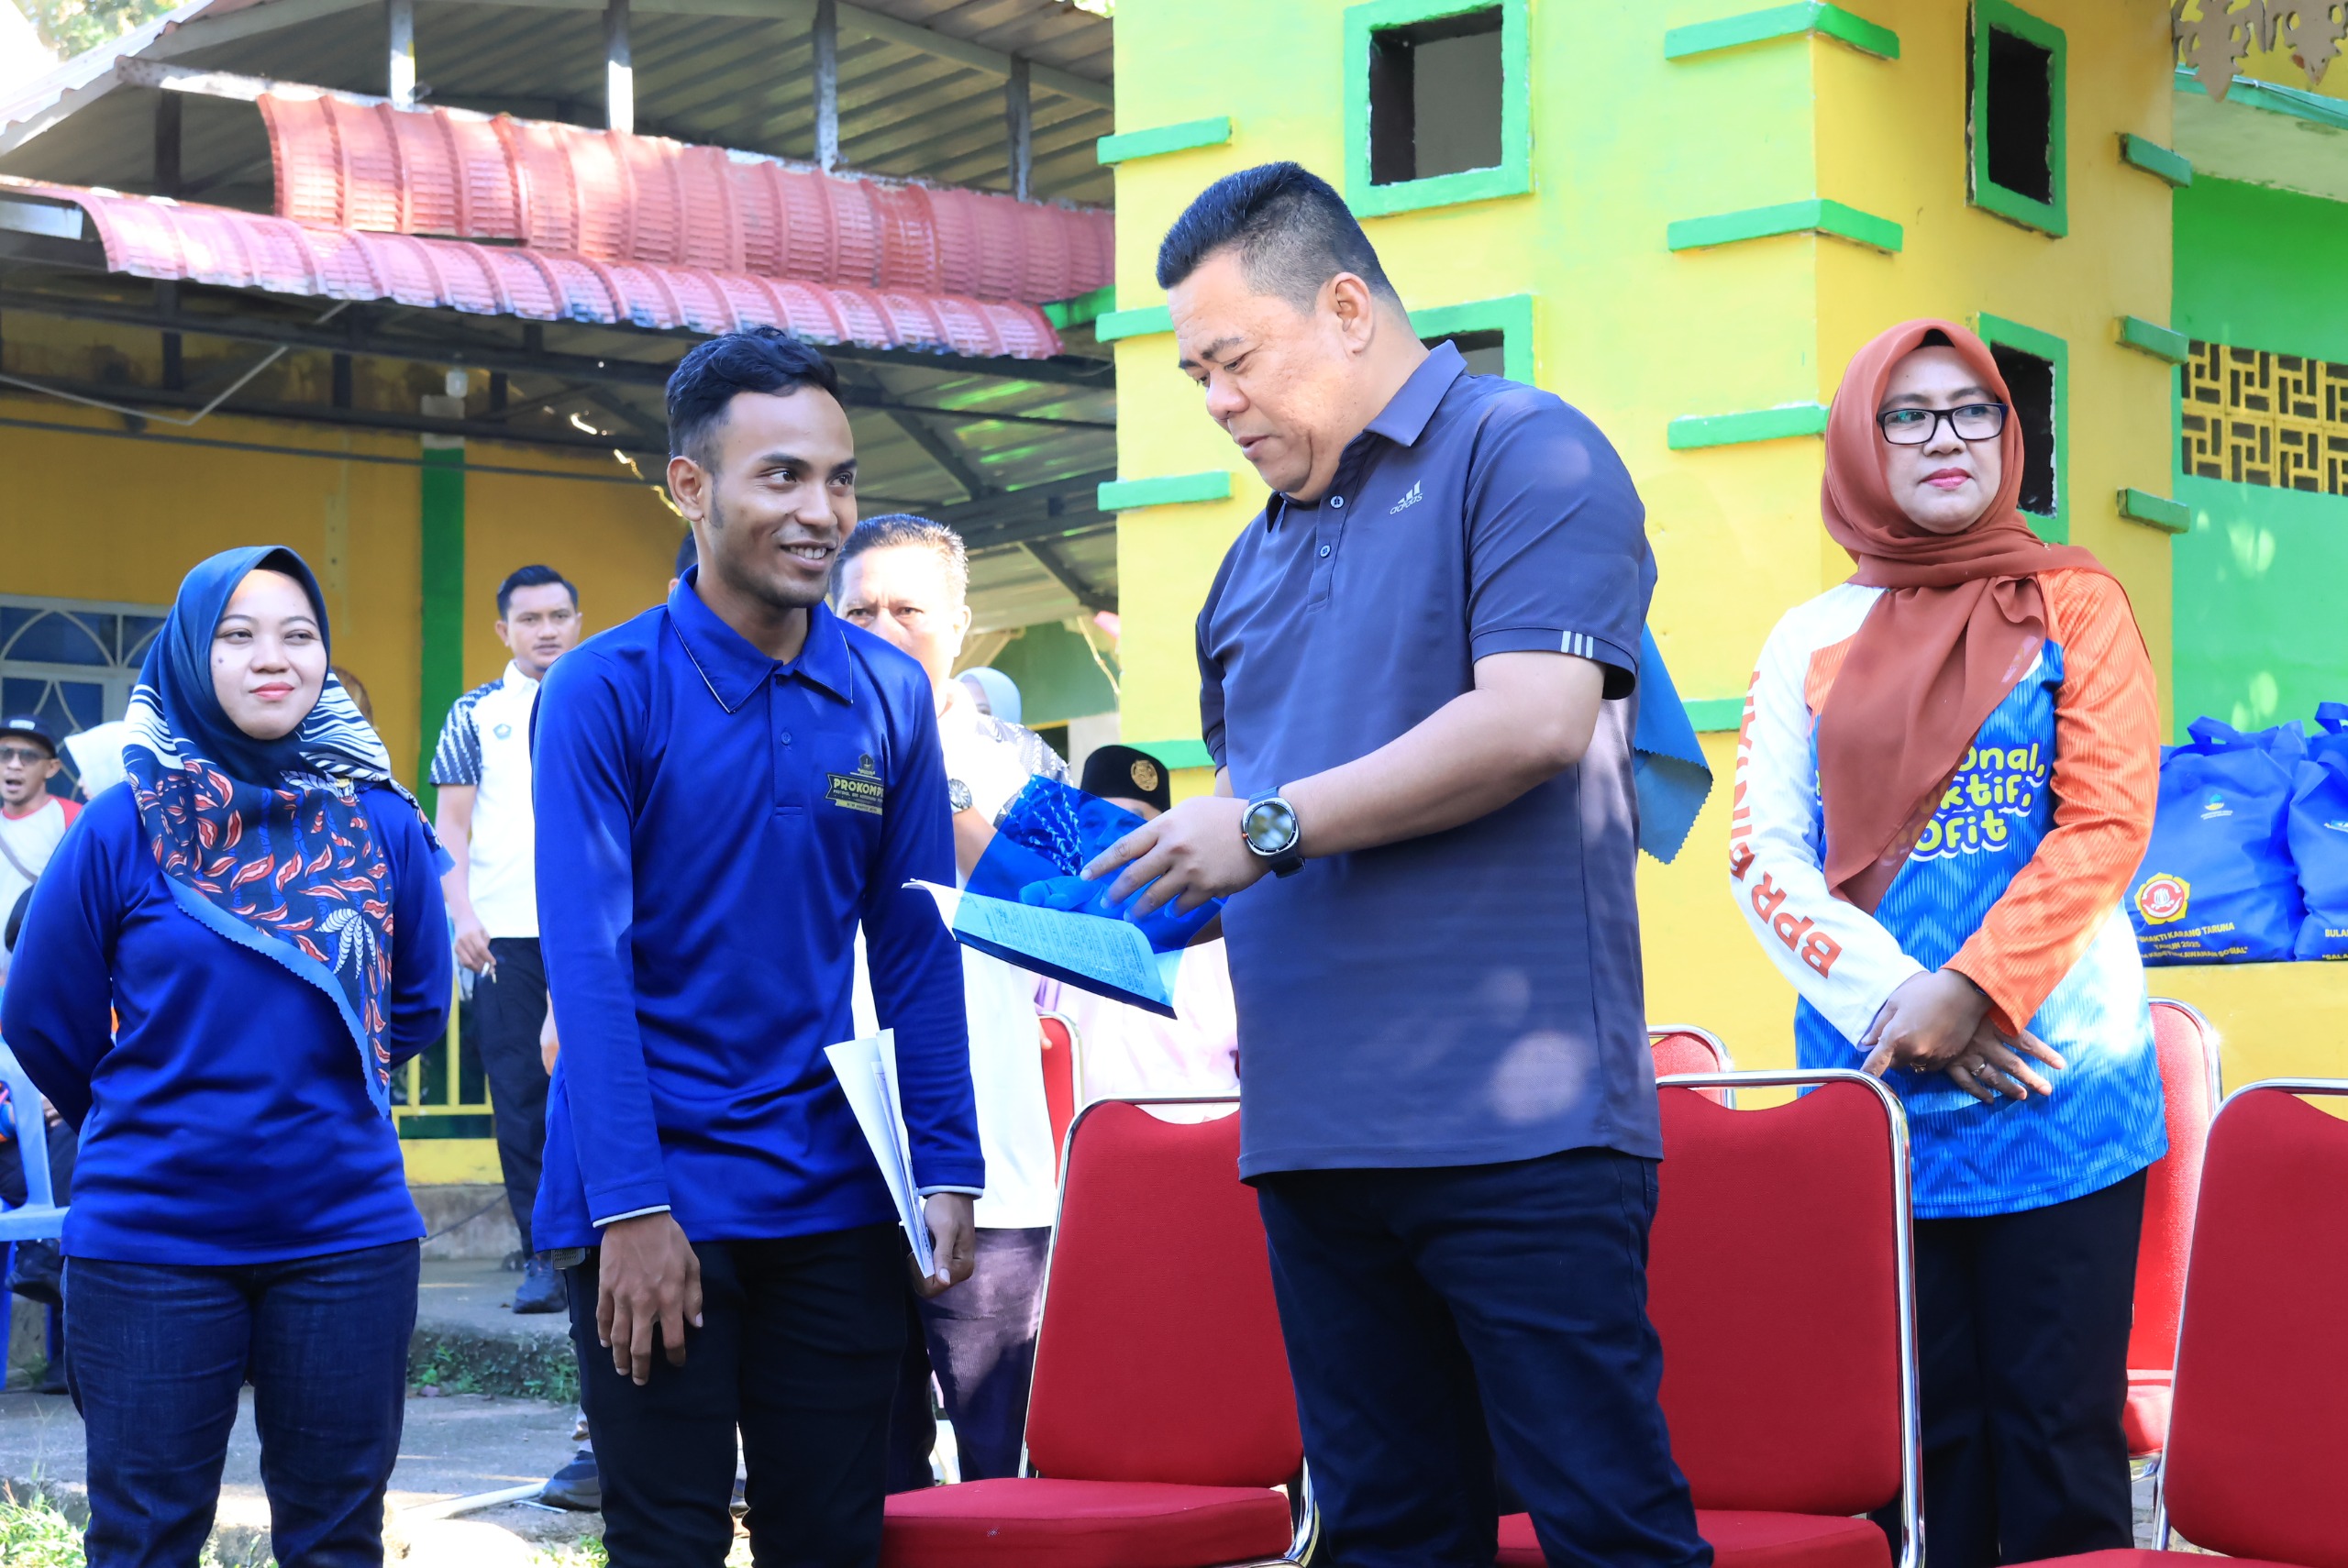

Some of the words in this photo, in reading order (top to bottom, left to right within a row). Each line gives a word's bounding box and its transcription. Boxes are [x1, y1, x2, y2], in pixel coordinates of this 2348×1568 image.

[1390, 492, 1423, 514] adidas
[1751, 871, 1842, 979] BPR
[2201, 922, 2234, 934] TARUNA
[2324, 929, 2348, 937] BULA
